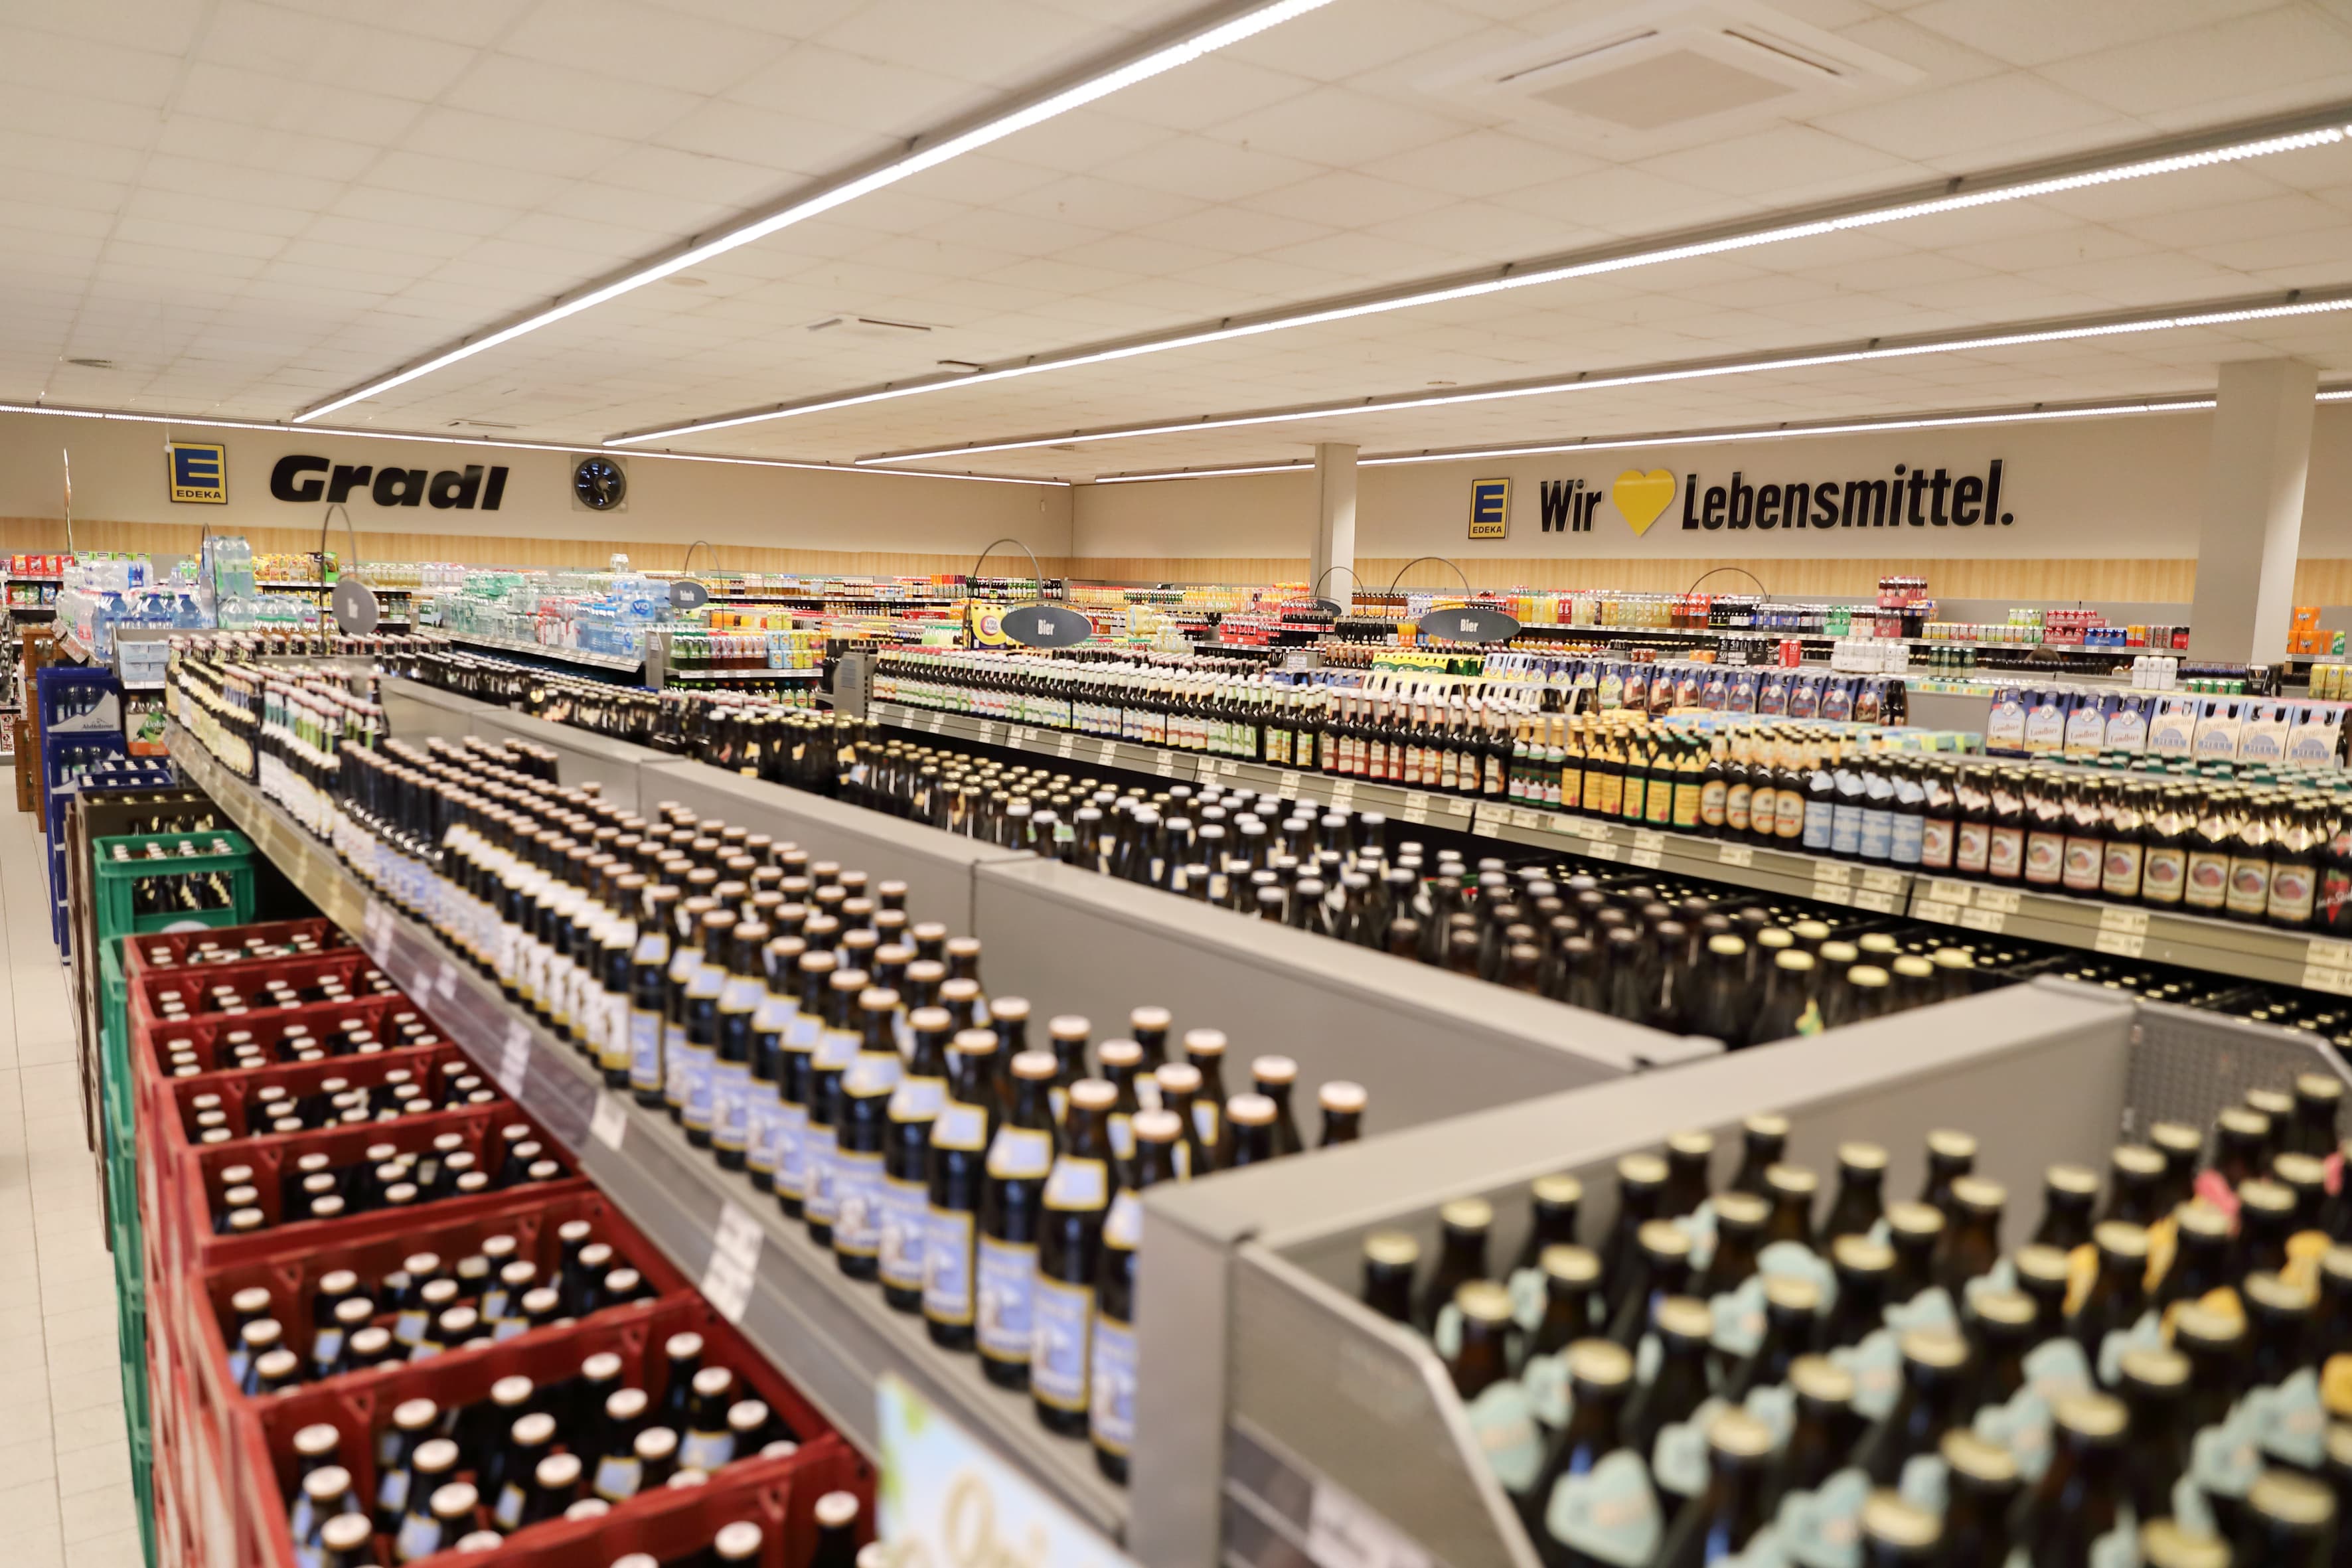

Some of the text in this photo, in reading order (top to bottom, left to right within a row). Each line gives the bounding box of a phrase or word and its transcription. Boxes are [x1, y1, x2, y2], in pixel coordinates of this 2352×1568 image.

[270, 455, 509, 510] Gradl
[177, 490, 221, 499] EDEKA
[1540, 459, 2015, 532] Wir Lebensmittel.
[1038, 619, 1054, 635] Bier
[1460, 618, 1478, 632] Bier
[2030, 727, 2058, 736] Landbier
[2070, 730, 2099, 740] Landbier
[2110, 734, 2139, 744] Landbier
